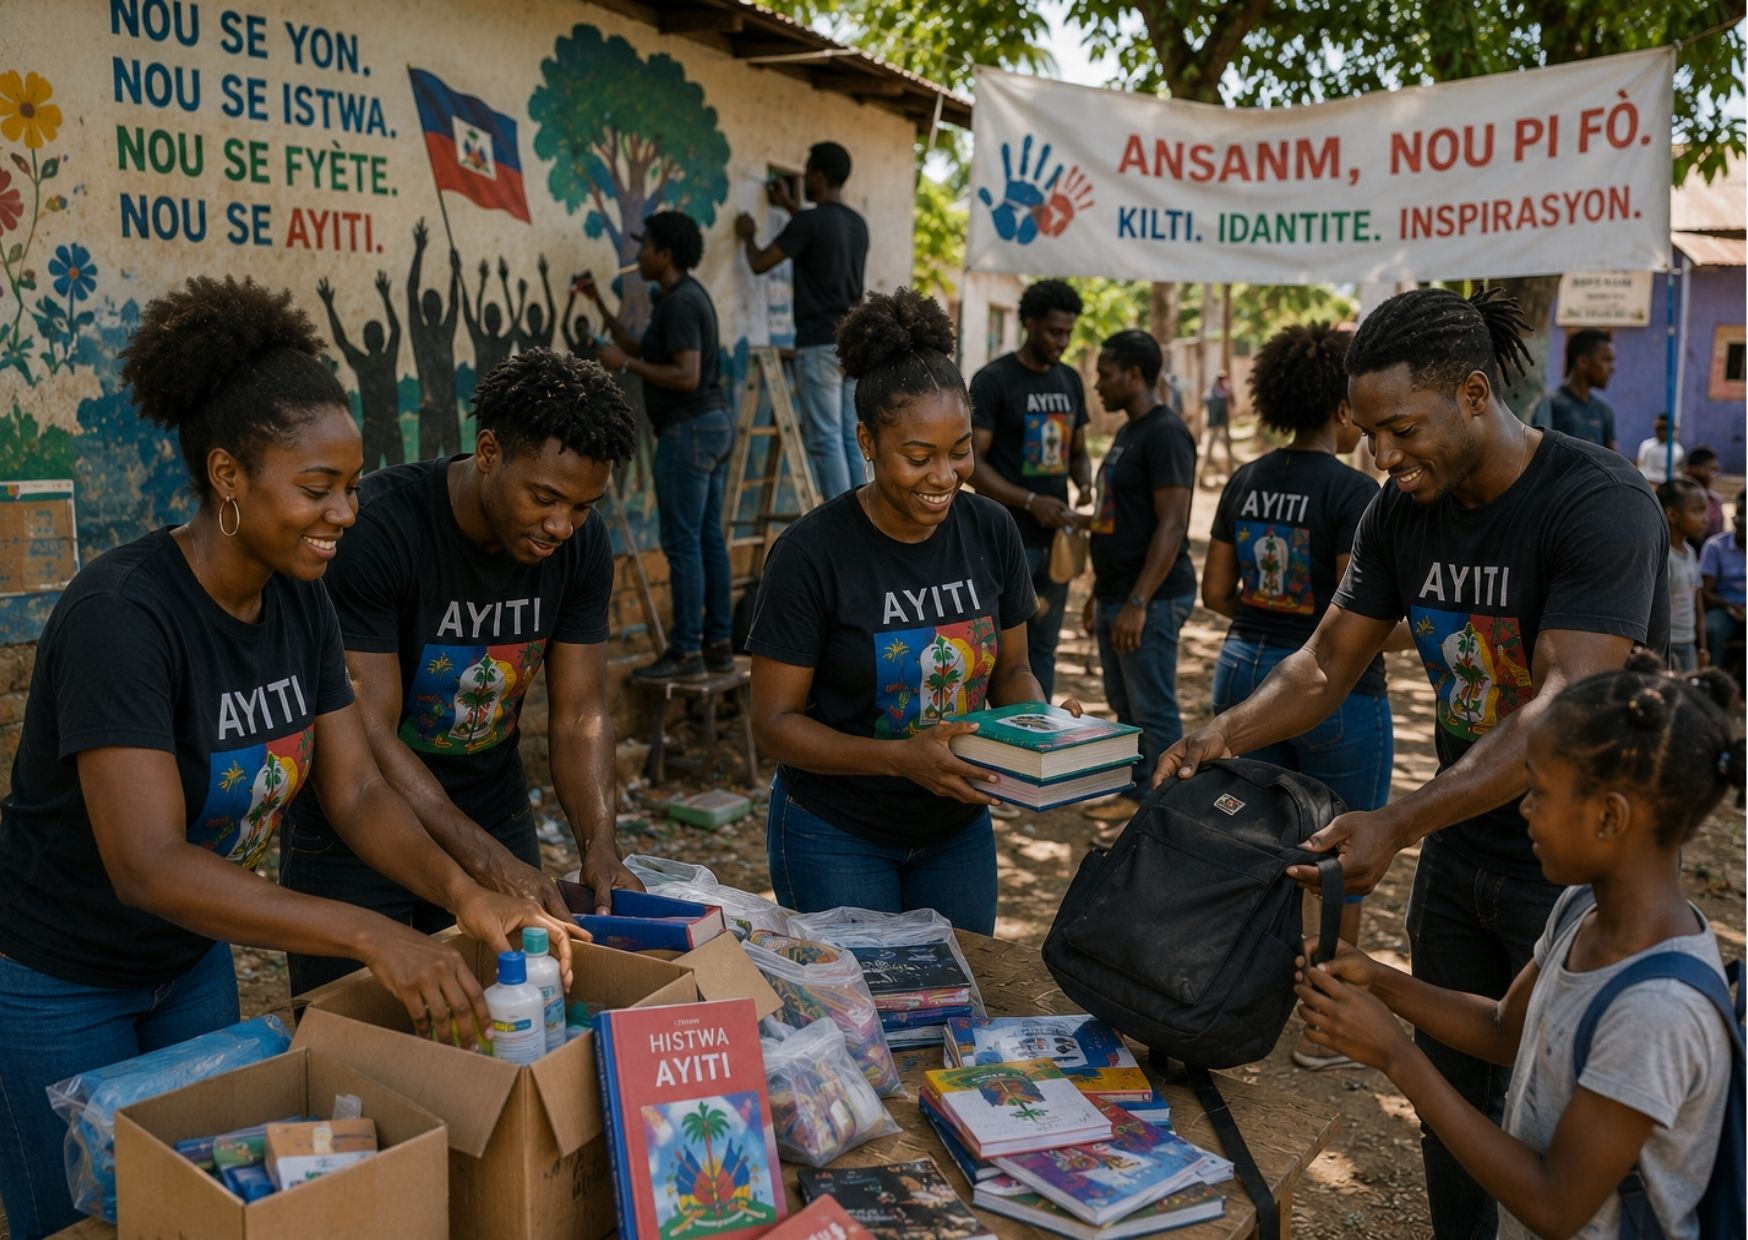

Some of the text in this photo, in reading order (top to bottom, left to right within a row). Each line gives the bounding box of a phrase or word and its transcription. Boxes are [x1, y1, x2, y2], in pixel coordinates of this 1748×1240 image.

[111, 0, 371, 76] NOU SE YON.
[113, 56, 397, 138] NOU SE ISTWA.
[116, 125, 399, 197] NOU SE FYÈTE.
[1118, 88, 1652, 186] ANSANM, NOU PI FÒ.
[120, 193, 385, 254] NOU SE AYITI.
[1117, 185, 1642, 244] KILTI. IDANTITE. INSPIRASYON.
[1026, 392, 1072, 413] AYITI
[1240, 488, 1310, 524] AYITI
[881, 578, 981, 626] AYITI
[1418, 561, 1511, 608] AYITI
[436, 597, 541, 639] AYITI
[217, 674, 307, 741] AYITI
[649, 1027, 730, 1054] HISTWA
[655, 1052, 732, 1088] AYITI
